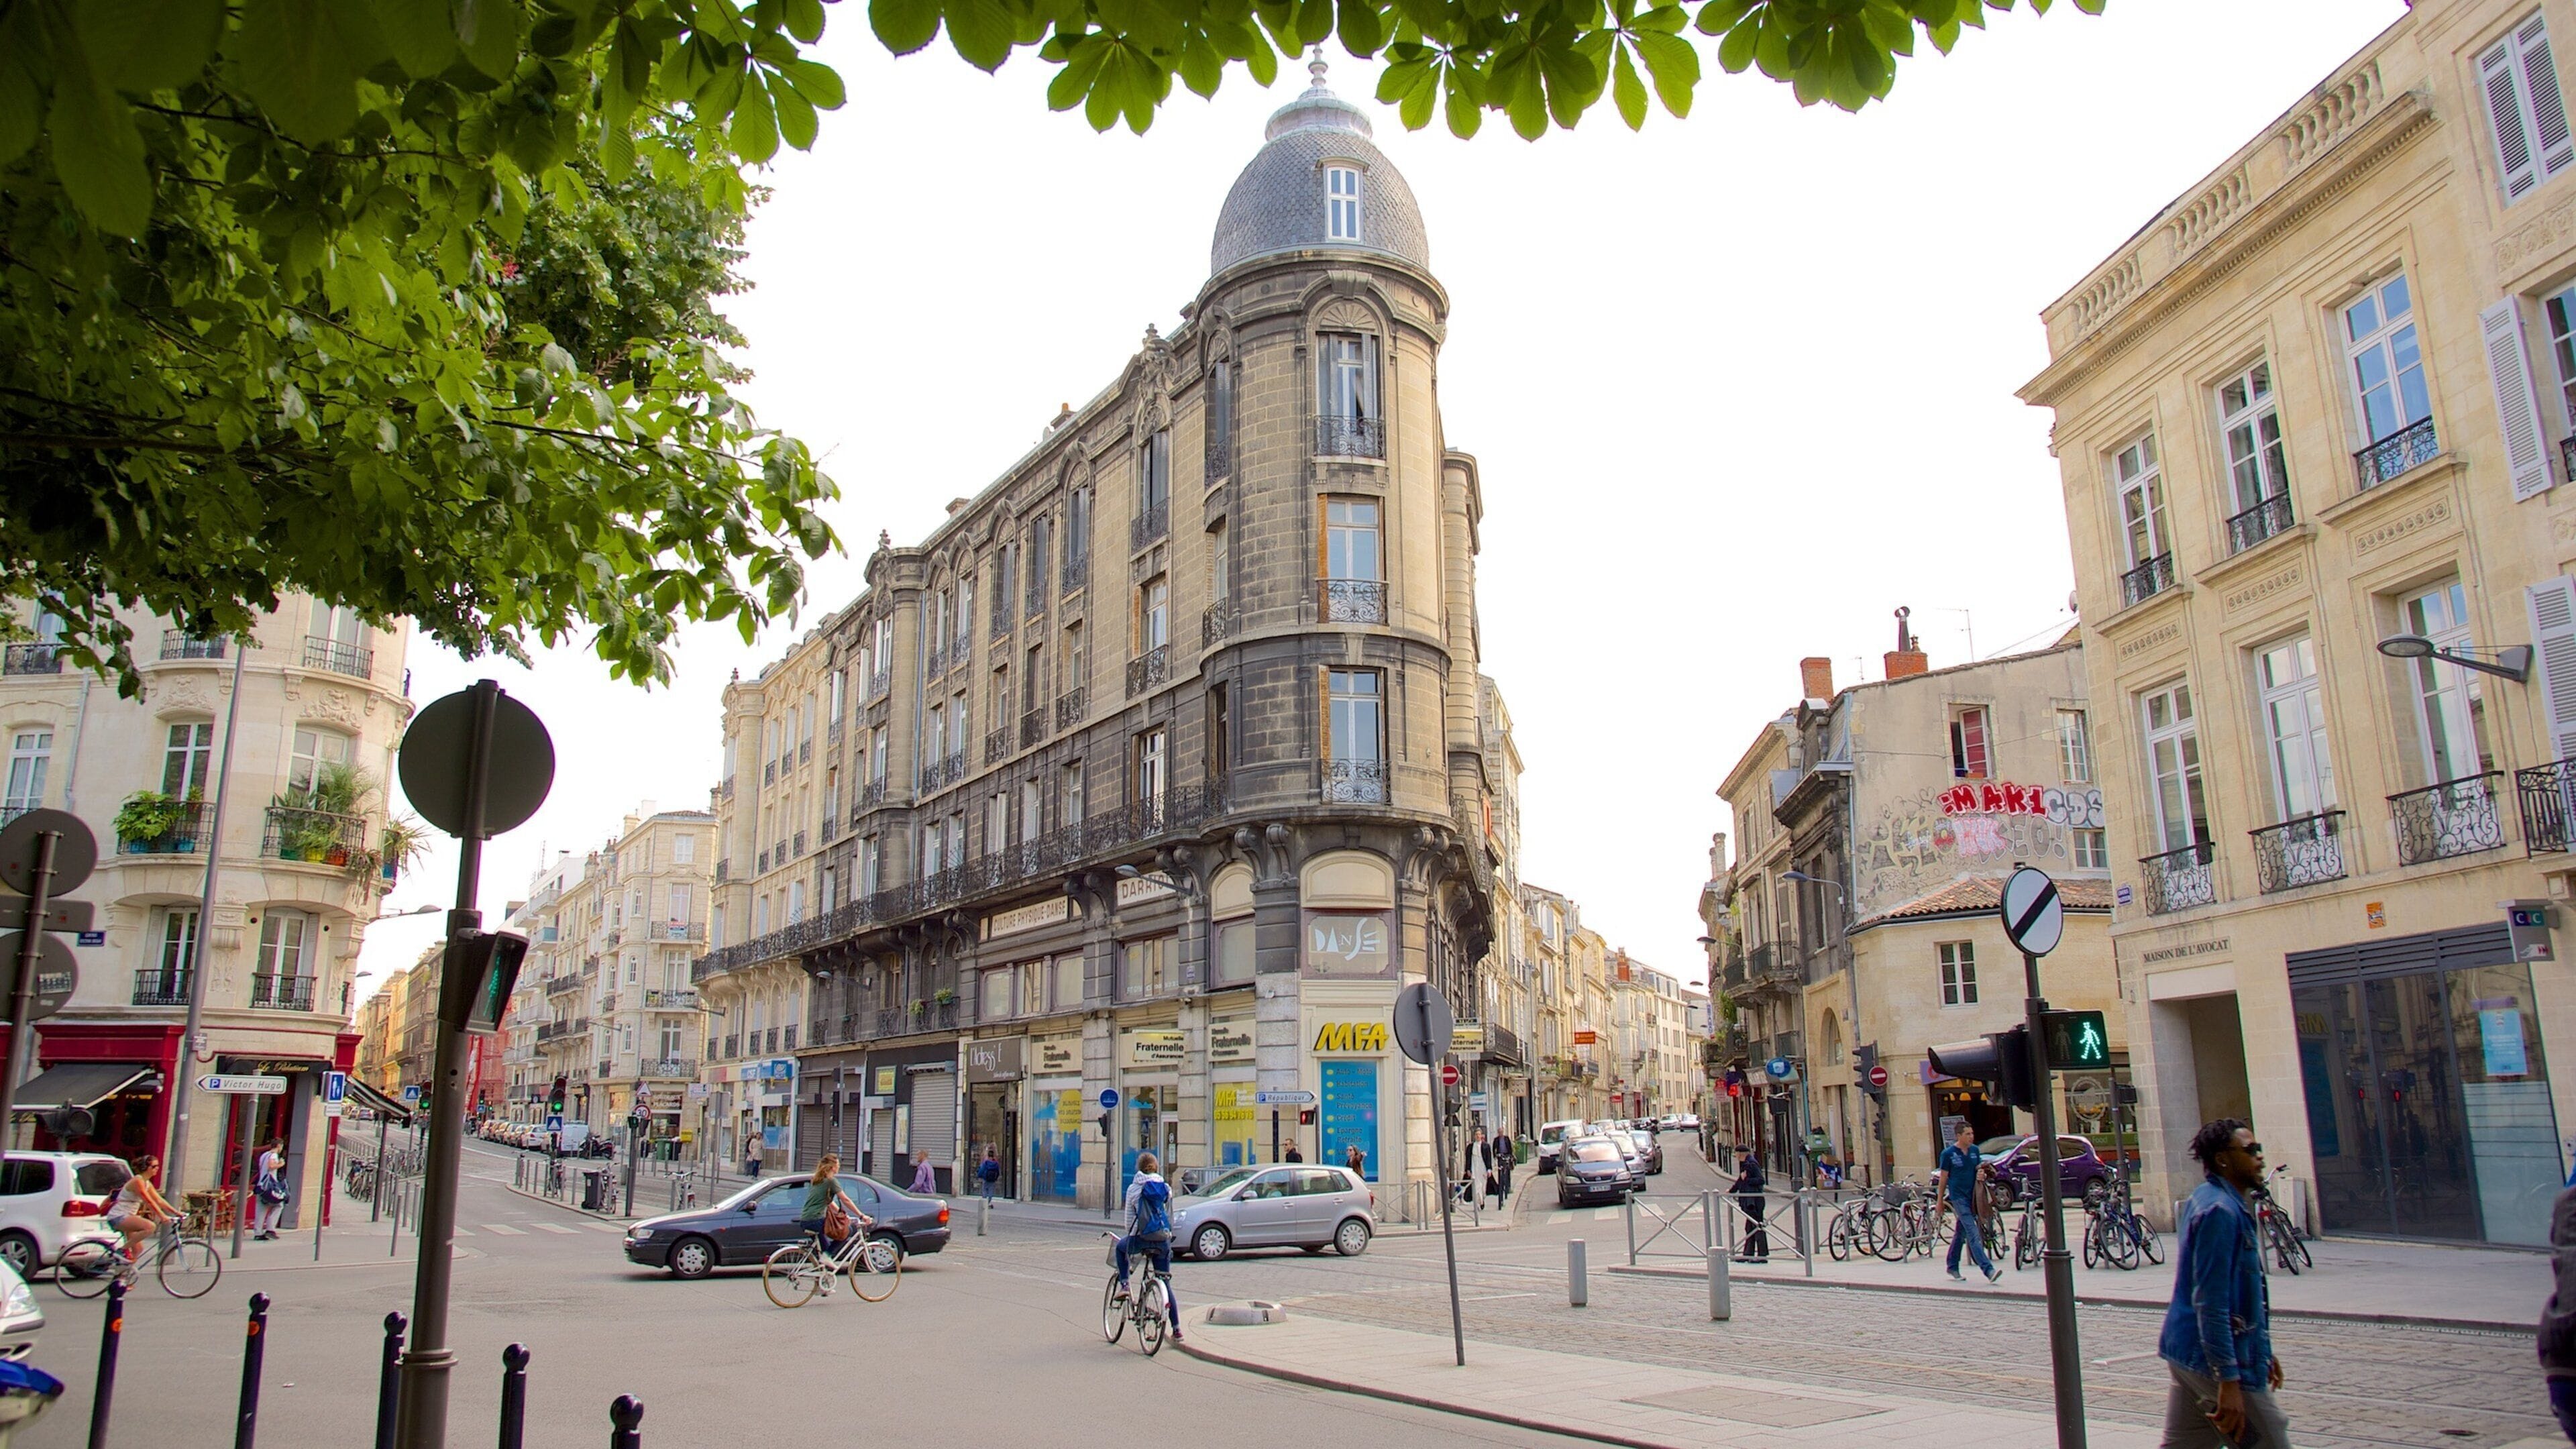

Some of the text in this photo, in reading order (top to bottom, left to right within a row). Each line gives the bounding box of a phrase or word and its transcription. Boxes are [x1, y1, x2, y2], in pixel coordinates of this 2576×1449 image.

[994, 914, 1016, 932] CULTURE
[2516, 912, 2542, 924] CIC
[1314, 917, 1381, 961] DANSE
[2143, 939, 2229, 963] MAISON DE L'AVOCAT
[1313, 1022, 1389, 1051] MFA
[1136, 1042, 1184, 1052] Fraternelle
[258, 1081, 282, 1090] Hugo
[637, 1109, 647, 1117] 30
